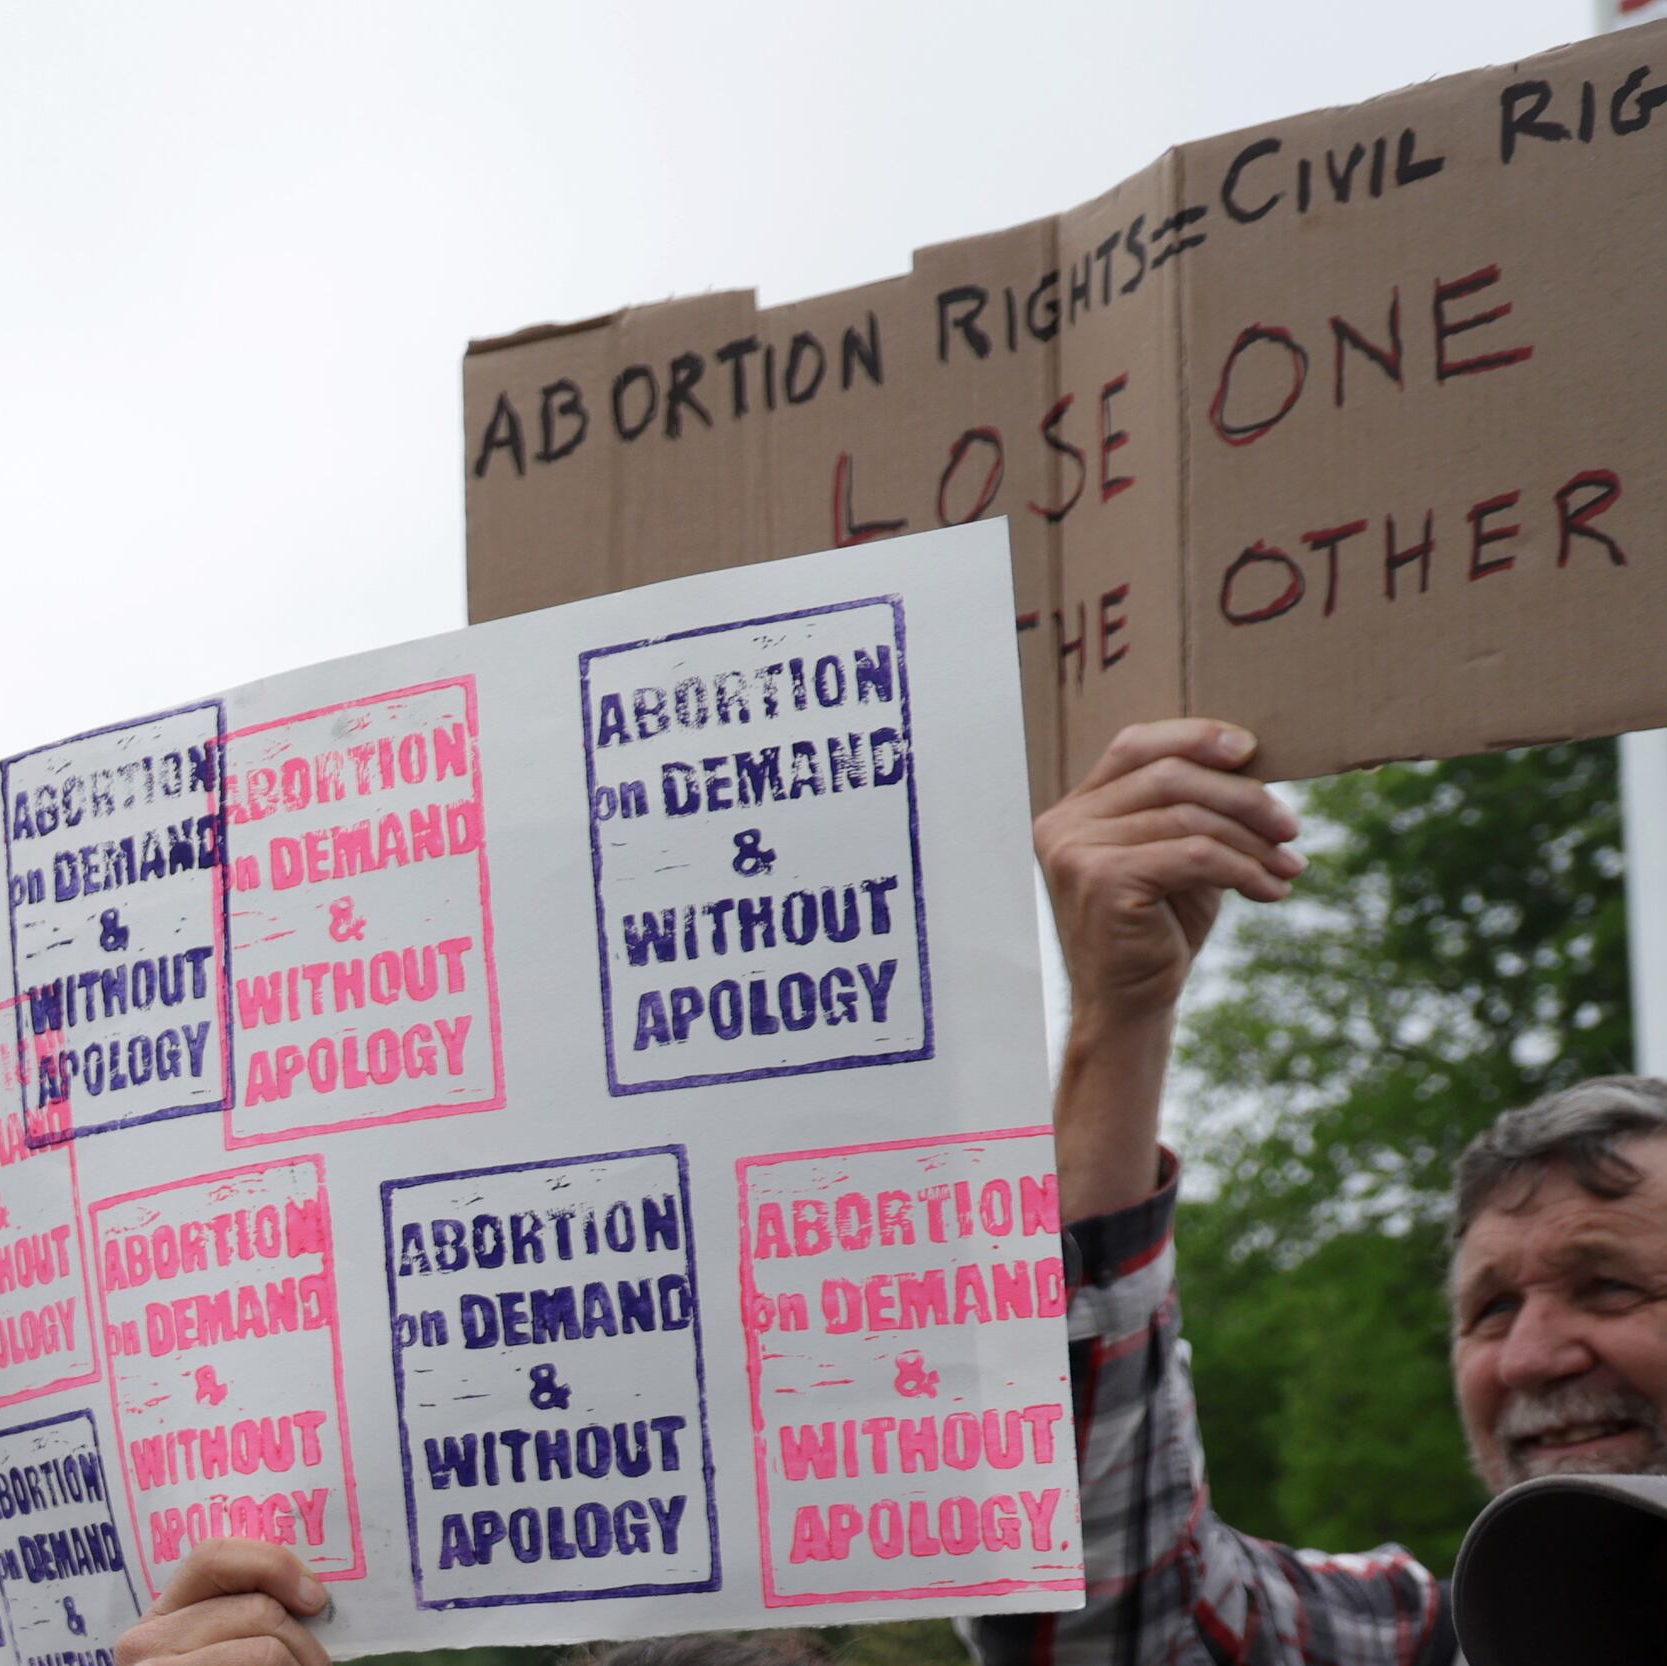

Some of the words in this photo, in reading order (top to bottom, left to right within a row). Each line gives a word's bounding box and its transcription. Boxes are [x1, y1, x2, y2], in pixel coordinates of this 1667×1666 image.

[474, 308, 883, 478] ABORTION
[1500, 65, 1667, 164] RIG
[835, 371, 1135, 547] LOSE
[1210, 263, 1534, 447] ONE
[1220, 468, 1627, 627] OTHER
[594, 644, 897, 750] ABORTION
[223, 720, 467, 826] ABORTION
[661, 727, 907, 821] DEMAND
[54, 813, 226, 902] DEMAND
[269, 800, 481, 893] DEMAND
[731, 828, 777, 877] &
[99, 907, 130, 952] &
[326, 896, 367, 942] &
[623, 875, 898, 968] WITHOUT
[29, 946, 213, 1035] WITHOUT
[235, 935, 471, 1031] WITHOUT
[633, 957, 899, 1051] APOLOGY
[37, 1020, 213, 1110] APOLOGY
[244, 1015, 473, 1108] APOLOGY
[105, 1197, 326, 1293] ABORTION
[398, 1192, 681, 1278] ABORTION
[754, 1174, 1060, 1261] ABORTION
[145, 1274, 333, 1357] DEMAND
[461, 1274, 693, 1349] DEMAND
[820, 1256, 1065, 1336] DEMAND
[529, 1364, 570, 1409] &
[893, 1350, 941, 1398] &
[132, 1409, 328, 1491] WITHOUT
[423, 1414, 687, 1491] WITHOUT
[780, 1403, 1064, 1481] WITHOUT
[18, 1522, 125, 1584] DEMAND
[438, 1495, 688, 1569] APOLOGY
